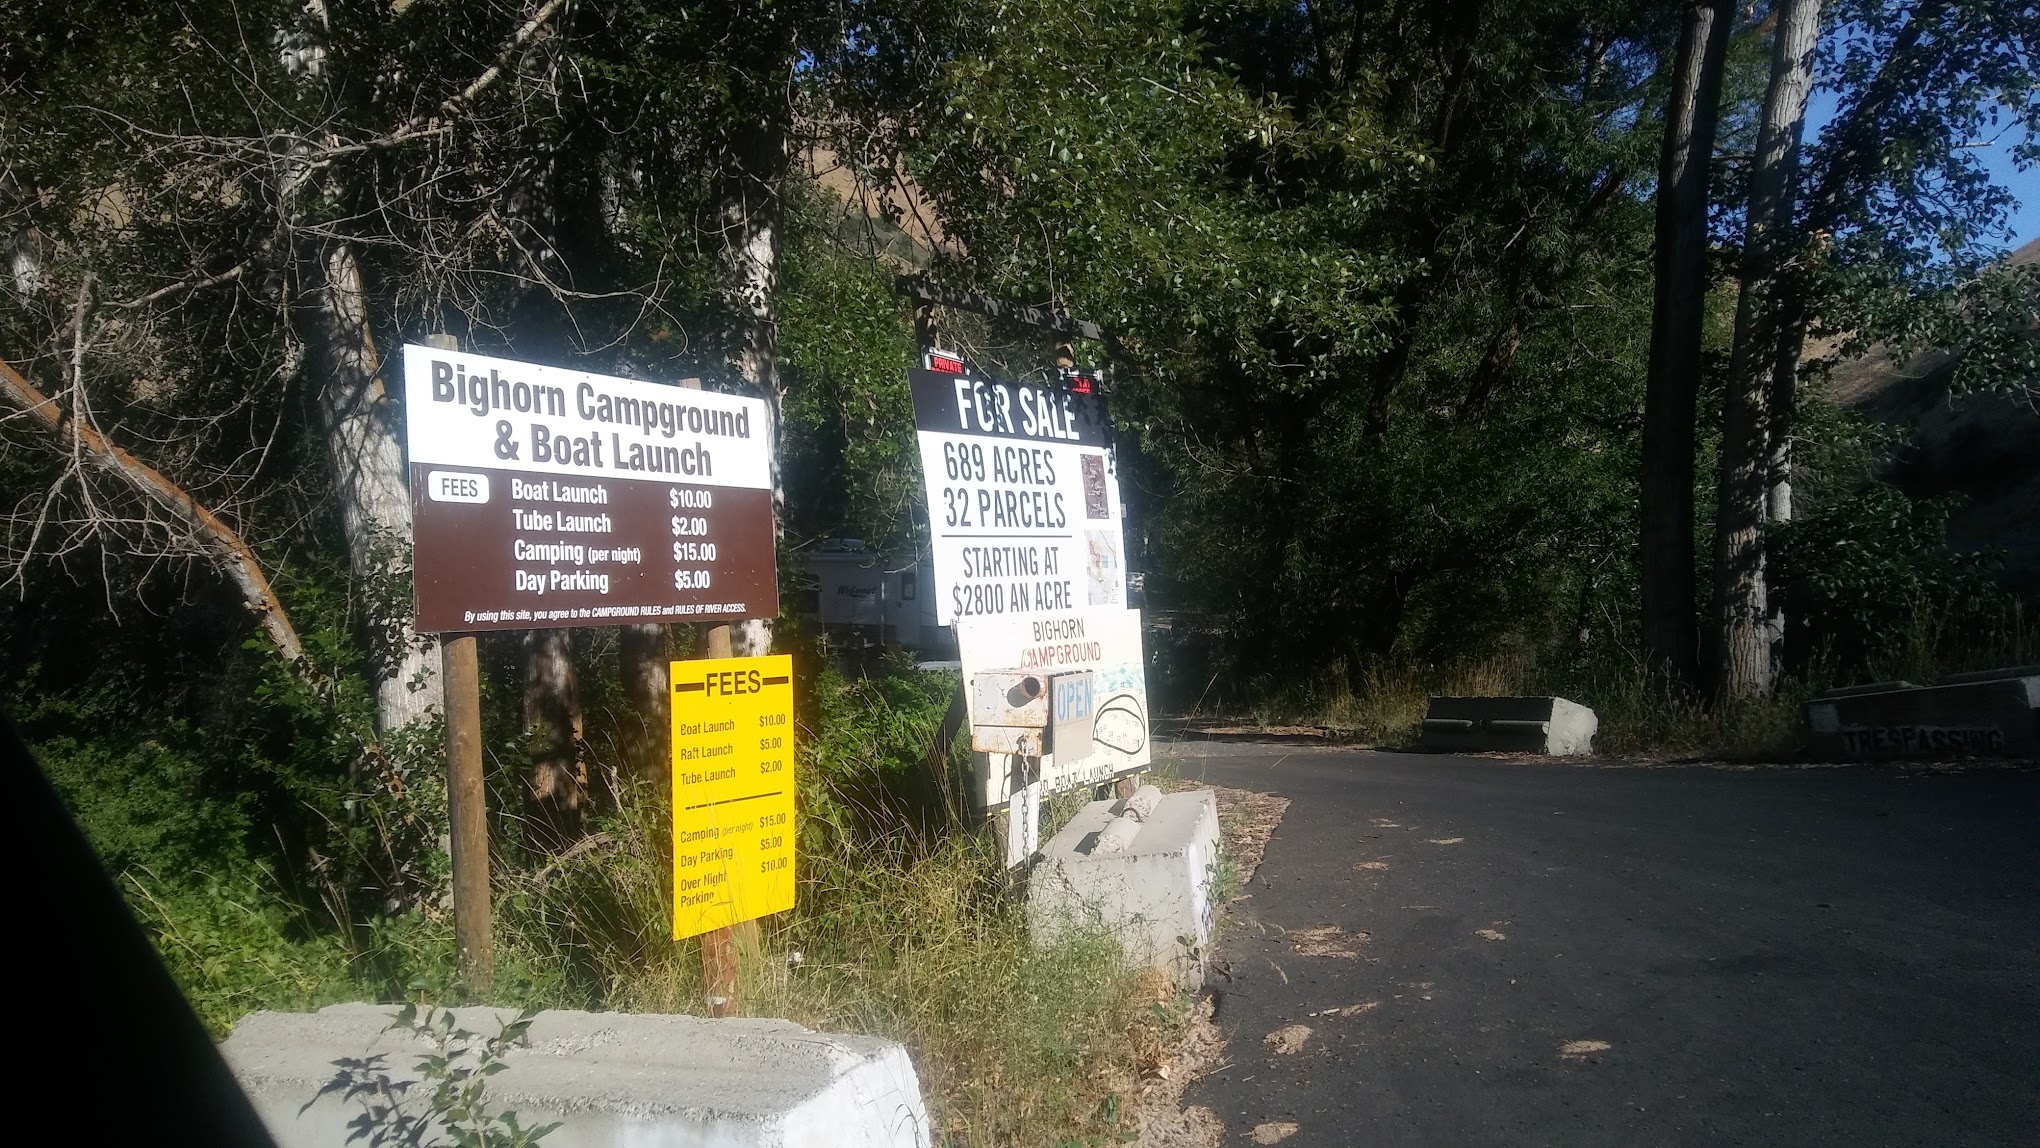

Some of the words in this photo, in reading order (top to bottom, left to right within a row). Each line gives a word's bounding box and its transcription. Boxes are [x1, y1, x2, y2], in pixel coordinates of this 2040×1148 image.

[933, 356, 963, 374] PRIVATE
[431, 360, 566, 417] Bighorn
[576, 382, 750, 438] Campground
[954, 378, 1015, 434] FOR
[1018, 387, 1080, 440] SALE
[494, 420, 519, 460] &
[531, 423, 604, 468] Boat
[613, 432, 712, 476] Launch
[943, 441, 986, 482] 689
[994, 446, 1056, 486] ACRES
[441, 477, 478, 498] FEES
[511, 478, 548, 501] Boat
[552, 482, 608, 505] Launch
[669, 489, 712, 510] $10.00
[943, 487, 972, 528] 32
[978, 489, 1066, 529] PARCELS
[512, 509, 553, 532] Tube
[556, 512, 611, 534] Launch
[671, 517, 707, 537] $2.00
[514, 539, 584, 565] Camping
[587, 547, 609, 564] (per
[611, 547, 642, 565] night)
[673, 542, 716, 562] $15.00
[963, 547, 1039, 578] STARTING
[1045, 546, 1059, 575] AT
[515, 570, 546, 595] Day
[550, 570, 609, 594] Parking
[674, 570, 711, 591] $5.00
[953, 582, 1004, 618] $2800
[1011, 582, 1029, 613] AN
[1036, 580, 1072, 610] ACRE
[464, 610, 475, 624] By
[477, 610, 499, 624] using
[500, 609, 515, 621] this
[516, 609, 532, 621] site,
[533, 611, 547, 622] you
[548, 610, 569, 621] agree
[570, 608, 578, 618] to
[579, 608, 590, 618] the
[592, 605, 640, 618] CAMPGROUND
[640, 605, 662, 616] RULES
[662, 605, 674, 616] and
[674, 604, 695, 615] RULES
[695, 603, 704, 614] OF
[704, 603, 723, 614] RIVER
[722, 603, 746, 613] ACCESS.
[1033, 617, 1085, 642] BIGHORN
[1024, 641, 1101, 668] CAMPGROUND
[706, 670, 761, 697] FEES
[1057, 678, 1092, 721] OPEN
[680, 722, 701, 736] Boat
[703, 719, 735, 733] Launch
[759, 713, 786, 728] $10.00
[760, 737, 782, 751] $5.00
[1845, 726, 2006, 753] TRESPASSING
[680, 747, 699, 761] Raft
[701, 744, 733, 759] Launch
[680, 771, 702, 786] Tube
[704, 767, 736, 782] Launch
[760, 760, 782, 774] $2.00
[1055, 771, 1078, 794] BOAT
[1083, 763, 1115, 786] LAUNCH
[759, 812, 786, 828] $15.00
[680, 827, 720, 844] Camping
[722, 825, 735, 837] (per
[735, 822, 754, 834] night)
[760, 836, 782, 851] $5.00
[680, 855, 698, 868] Day
[700, 848, 734, 864] Parking
[761, 857, 787, 873] $10.00
[680, 878, 701, 892] Over
[703, 871, 727, 887] Night
